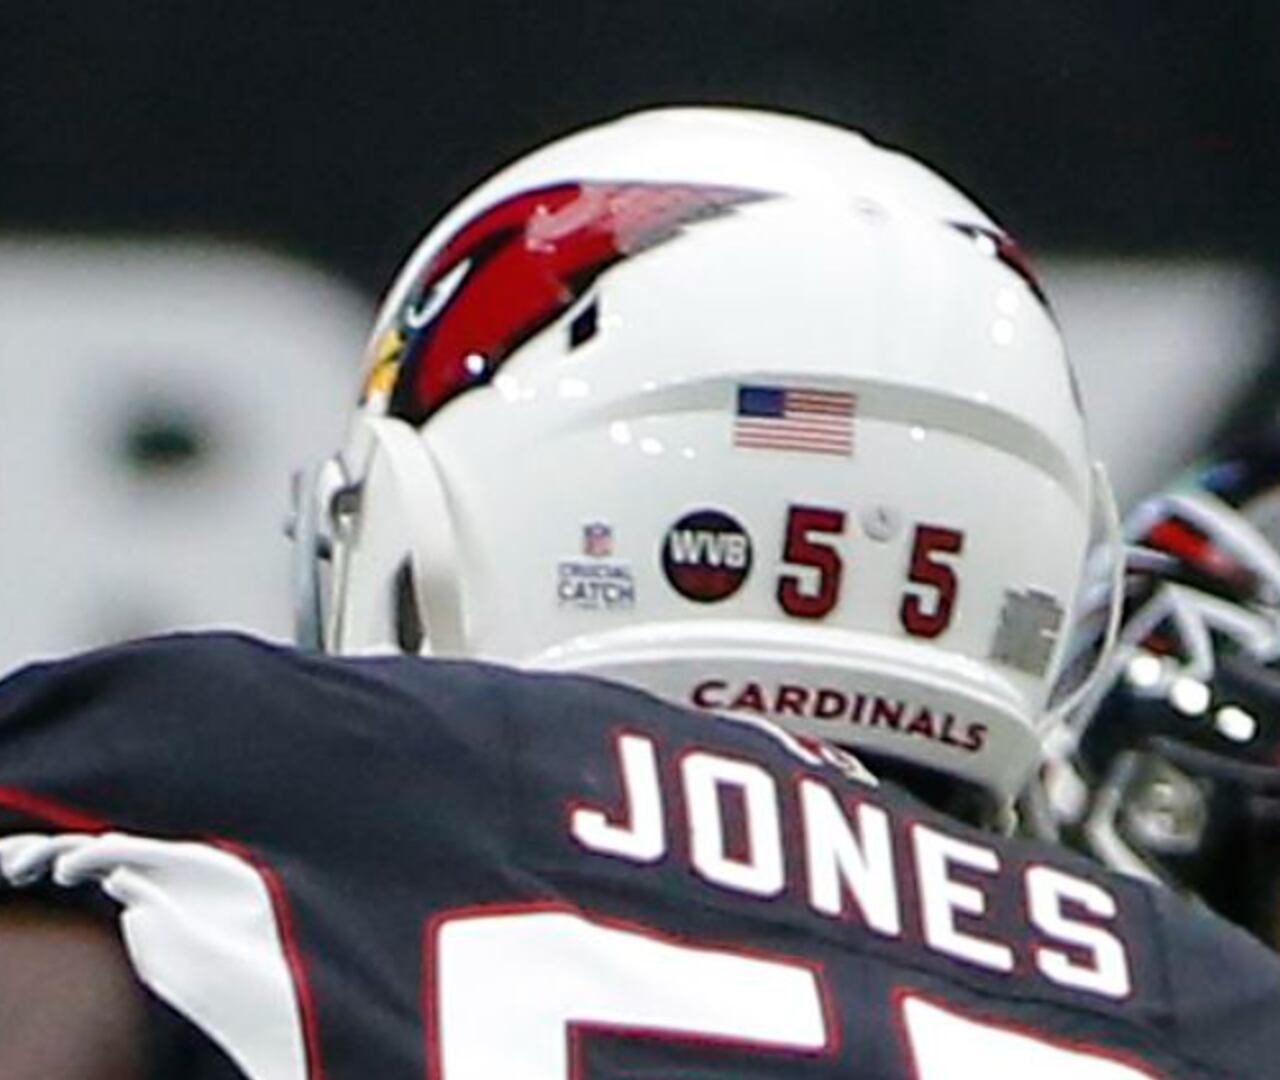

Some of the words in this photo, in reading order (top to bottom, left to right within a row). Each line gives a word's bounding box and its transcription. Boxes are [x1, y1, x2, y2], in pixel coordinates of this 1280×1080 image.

[670, 529, 749, 570] WVB
[557, 579, 636, 602] CATCH
[691, 679, 989, 752] CARDINALS
[569, 730, 1134, 1000] JONES
